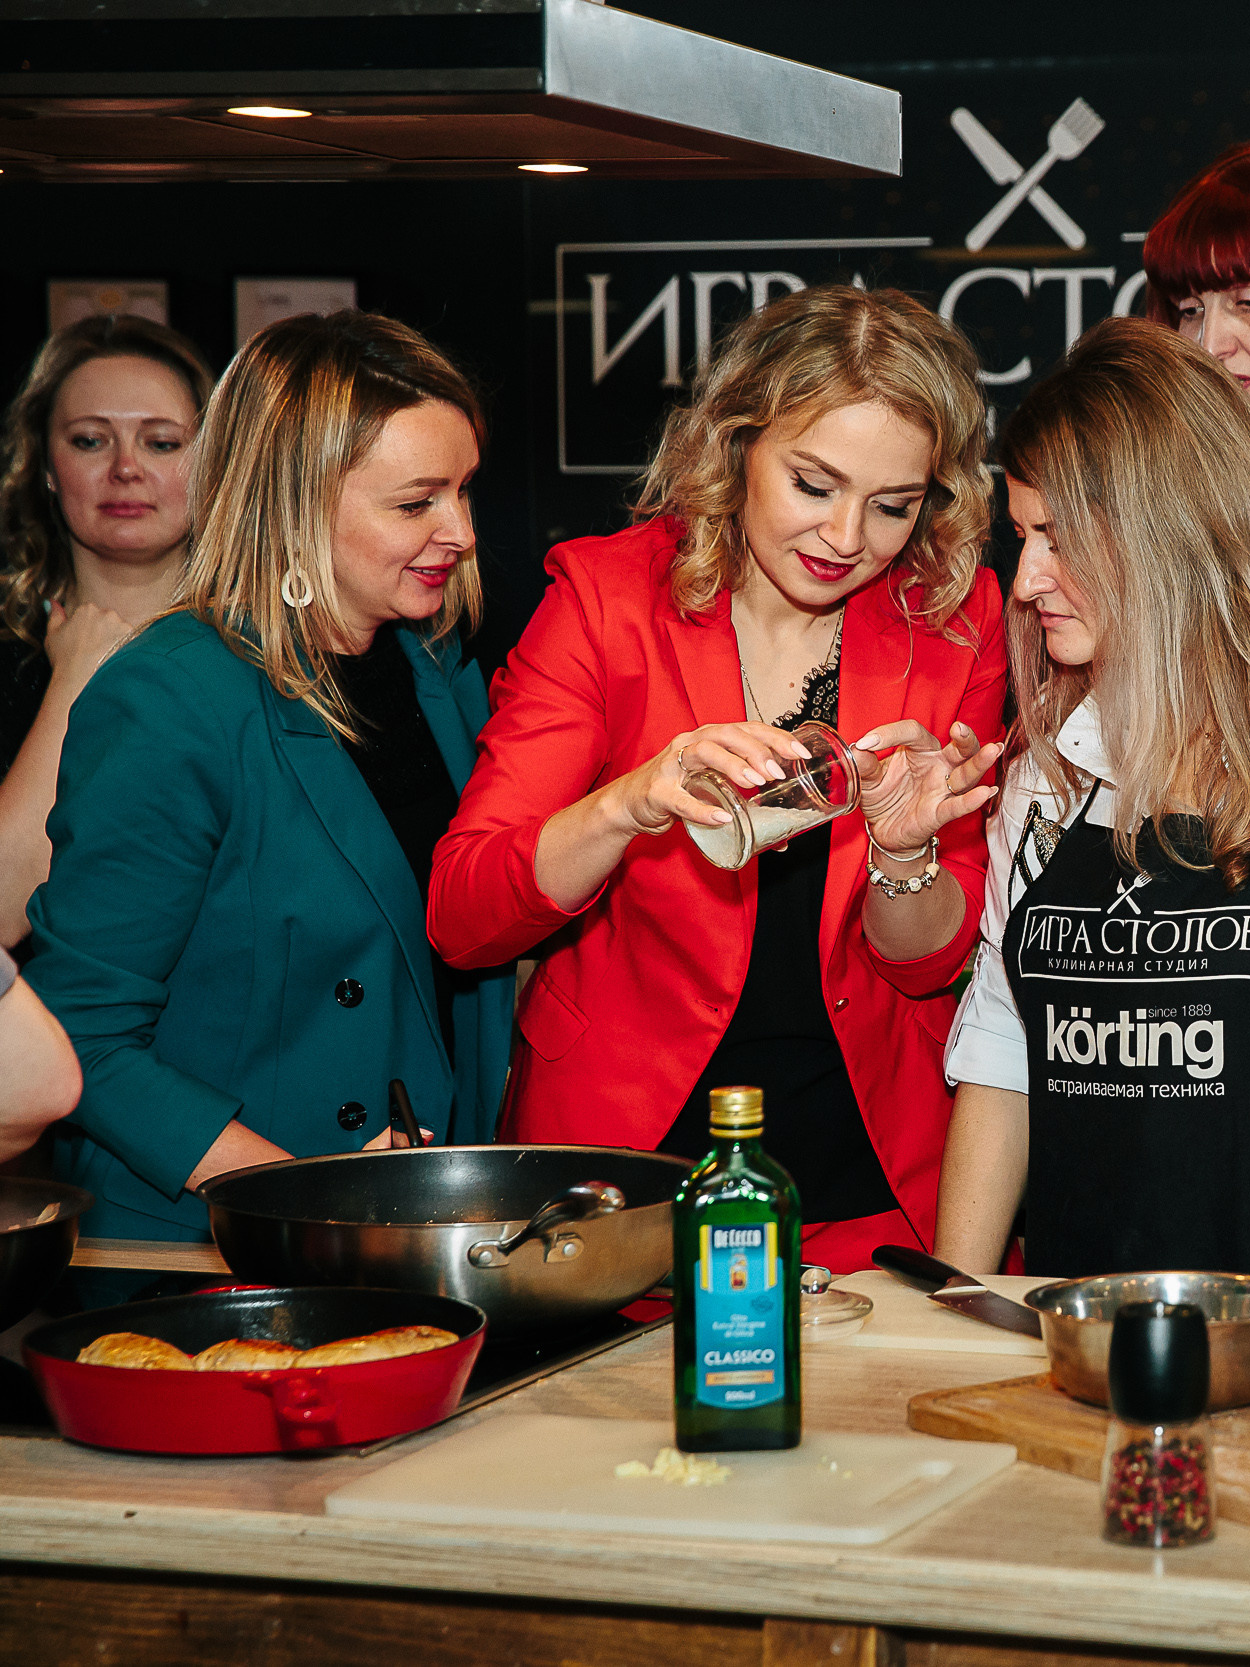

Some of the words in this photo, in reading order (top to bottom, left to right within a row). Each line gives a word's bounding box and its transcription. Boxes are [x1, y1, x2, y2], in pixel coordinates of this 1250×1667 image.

[1027, 915, 1092, 953] ИГРА
[1048, 957, 1134, 972] КУЛИНАРНАЯ
[1144, 958, 1208, 972] СТУДИЯ
[1148, 1006, 1177, 1018] since
[1182, 1004, 1212, 1017] 1889
[1046, 1004, 1224, 1080] körting
[1047, 1078, 1144, 1098] встраиваемая
[1150, 1081, 1225, 1098] техника
[703, 1348, 775, 1367] CLASSICO
